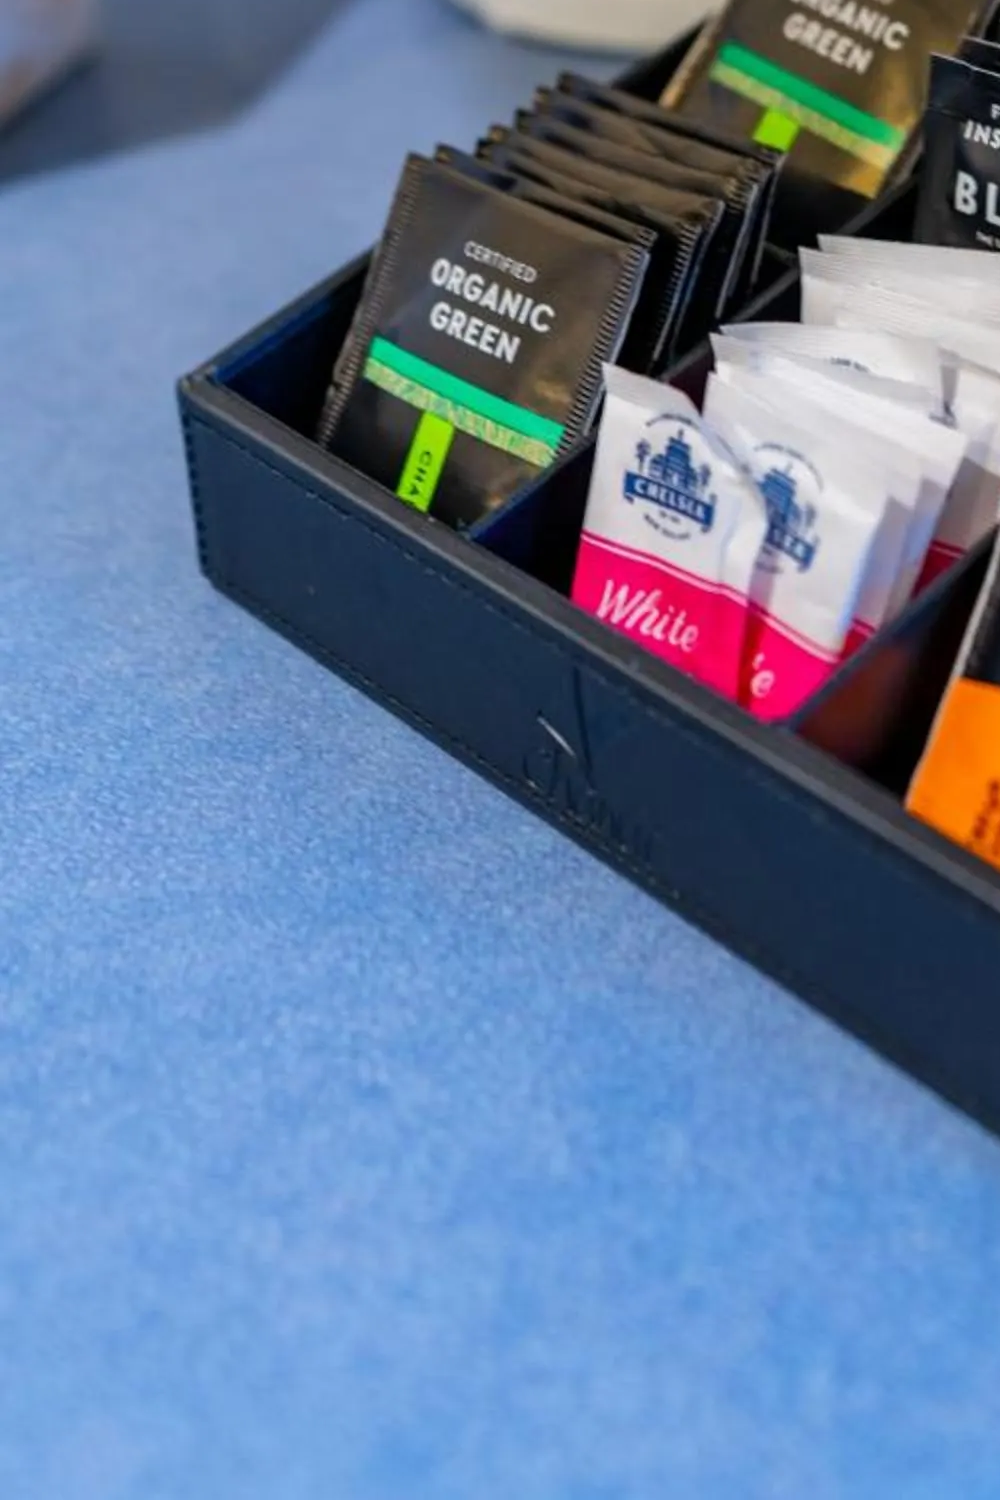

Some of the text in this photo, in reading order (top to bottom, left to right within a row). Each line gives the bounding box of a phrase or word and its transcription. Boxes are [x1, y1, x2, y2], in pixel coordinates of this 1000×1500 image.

[783, 12, 874, 75] GREEN
[463, 240, 538, 283] CERTIFIED
[431, 257, 556, 333] ORGANIC
[429, 301, 521, 364] GREEN
[409, 450, 433, 496] CHA
[633, 479, 704, 519] CHELSEA
[597, 579, 699, 652] White
